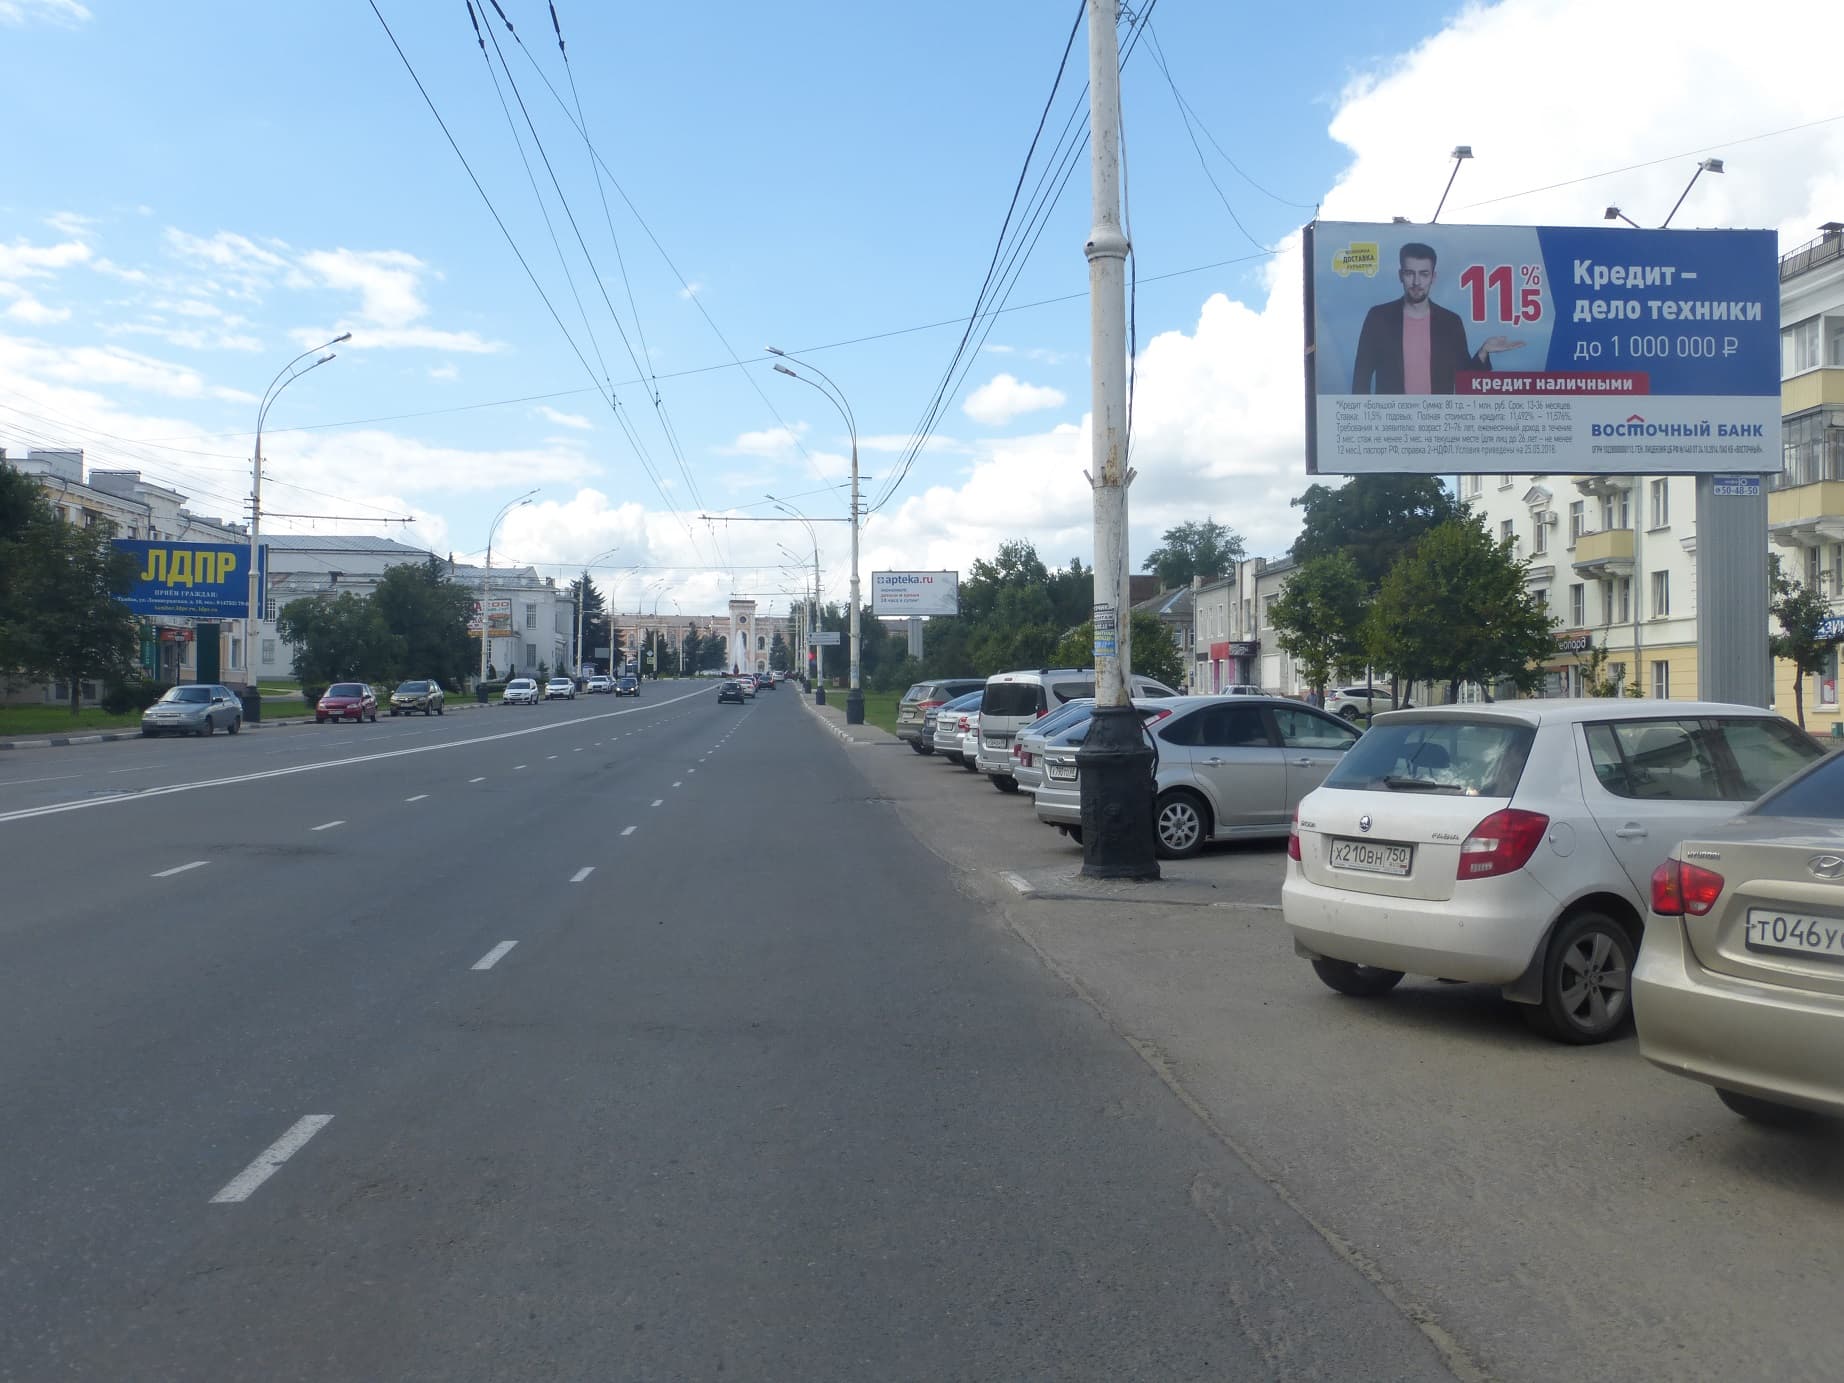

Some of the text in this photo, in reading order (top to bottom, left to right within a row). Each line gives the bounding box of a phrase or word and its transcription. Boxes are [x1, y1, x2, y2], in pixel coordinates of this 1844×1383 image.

[1343, 255, 1374, 264] ДОСТАВКА
[1573, 260, 1675, 290] Кредит
[1573, 299, 1762, 322] дело техники
[1574, 339, 1601, 360] до
[1610, 335, 1620, 356] 1
[1629, 336, 1669, 357] 000
[1677, 336, 1716, 357] 000
[1472, 377, 1633, 392] кредит наличными
[1592, 418, 1763, 437] ВОСТОЧНЫЙ БАНК
[1722, 486, 1758, 495] 50-48-50
[141, 549, 237, 588] ЛДПР
[885, 574, 933, 585] apteka.ru
[1335, 844, 1406, 866] Х210ВН 750
